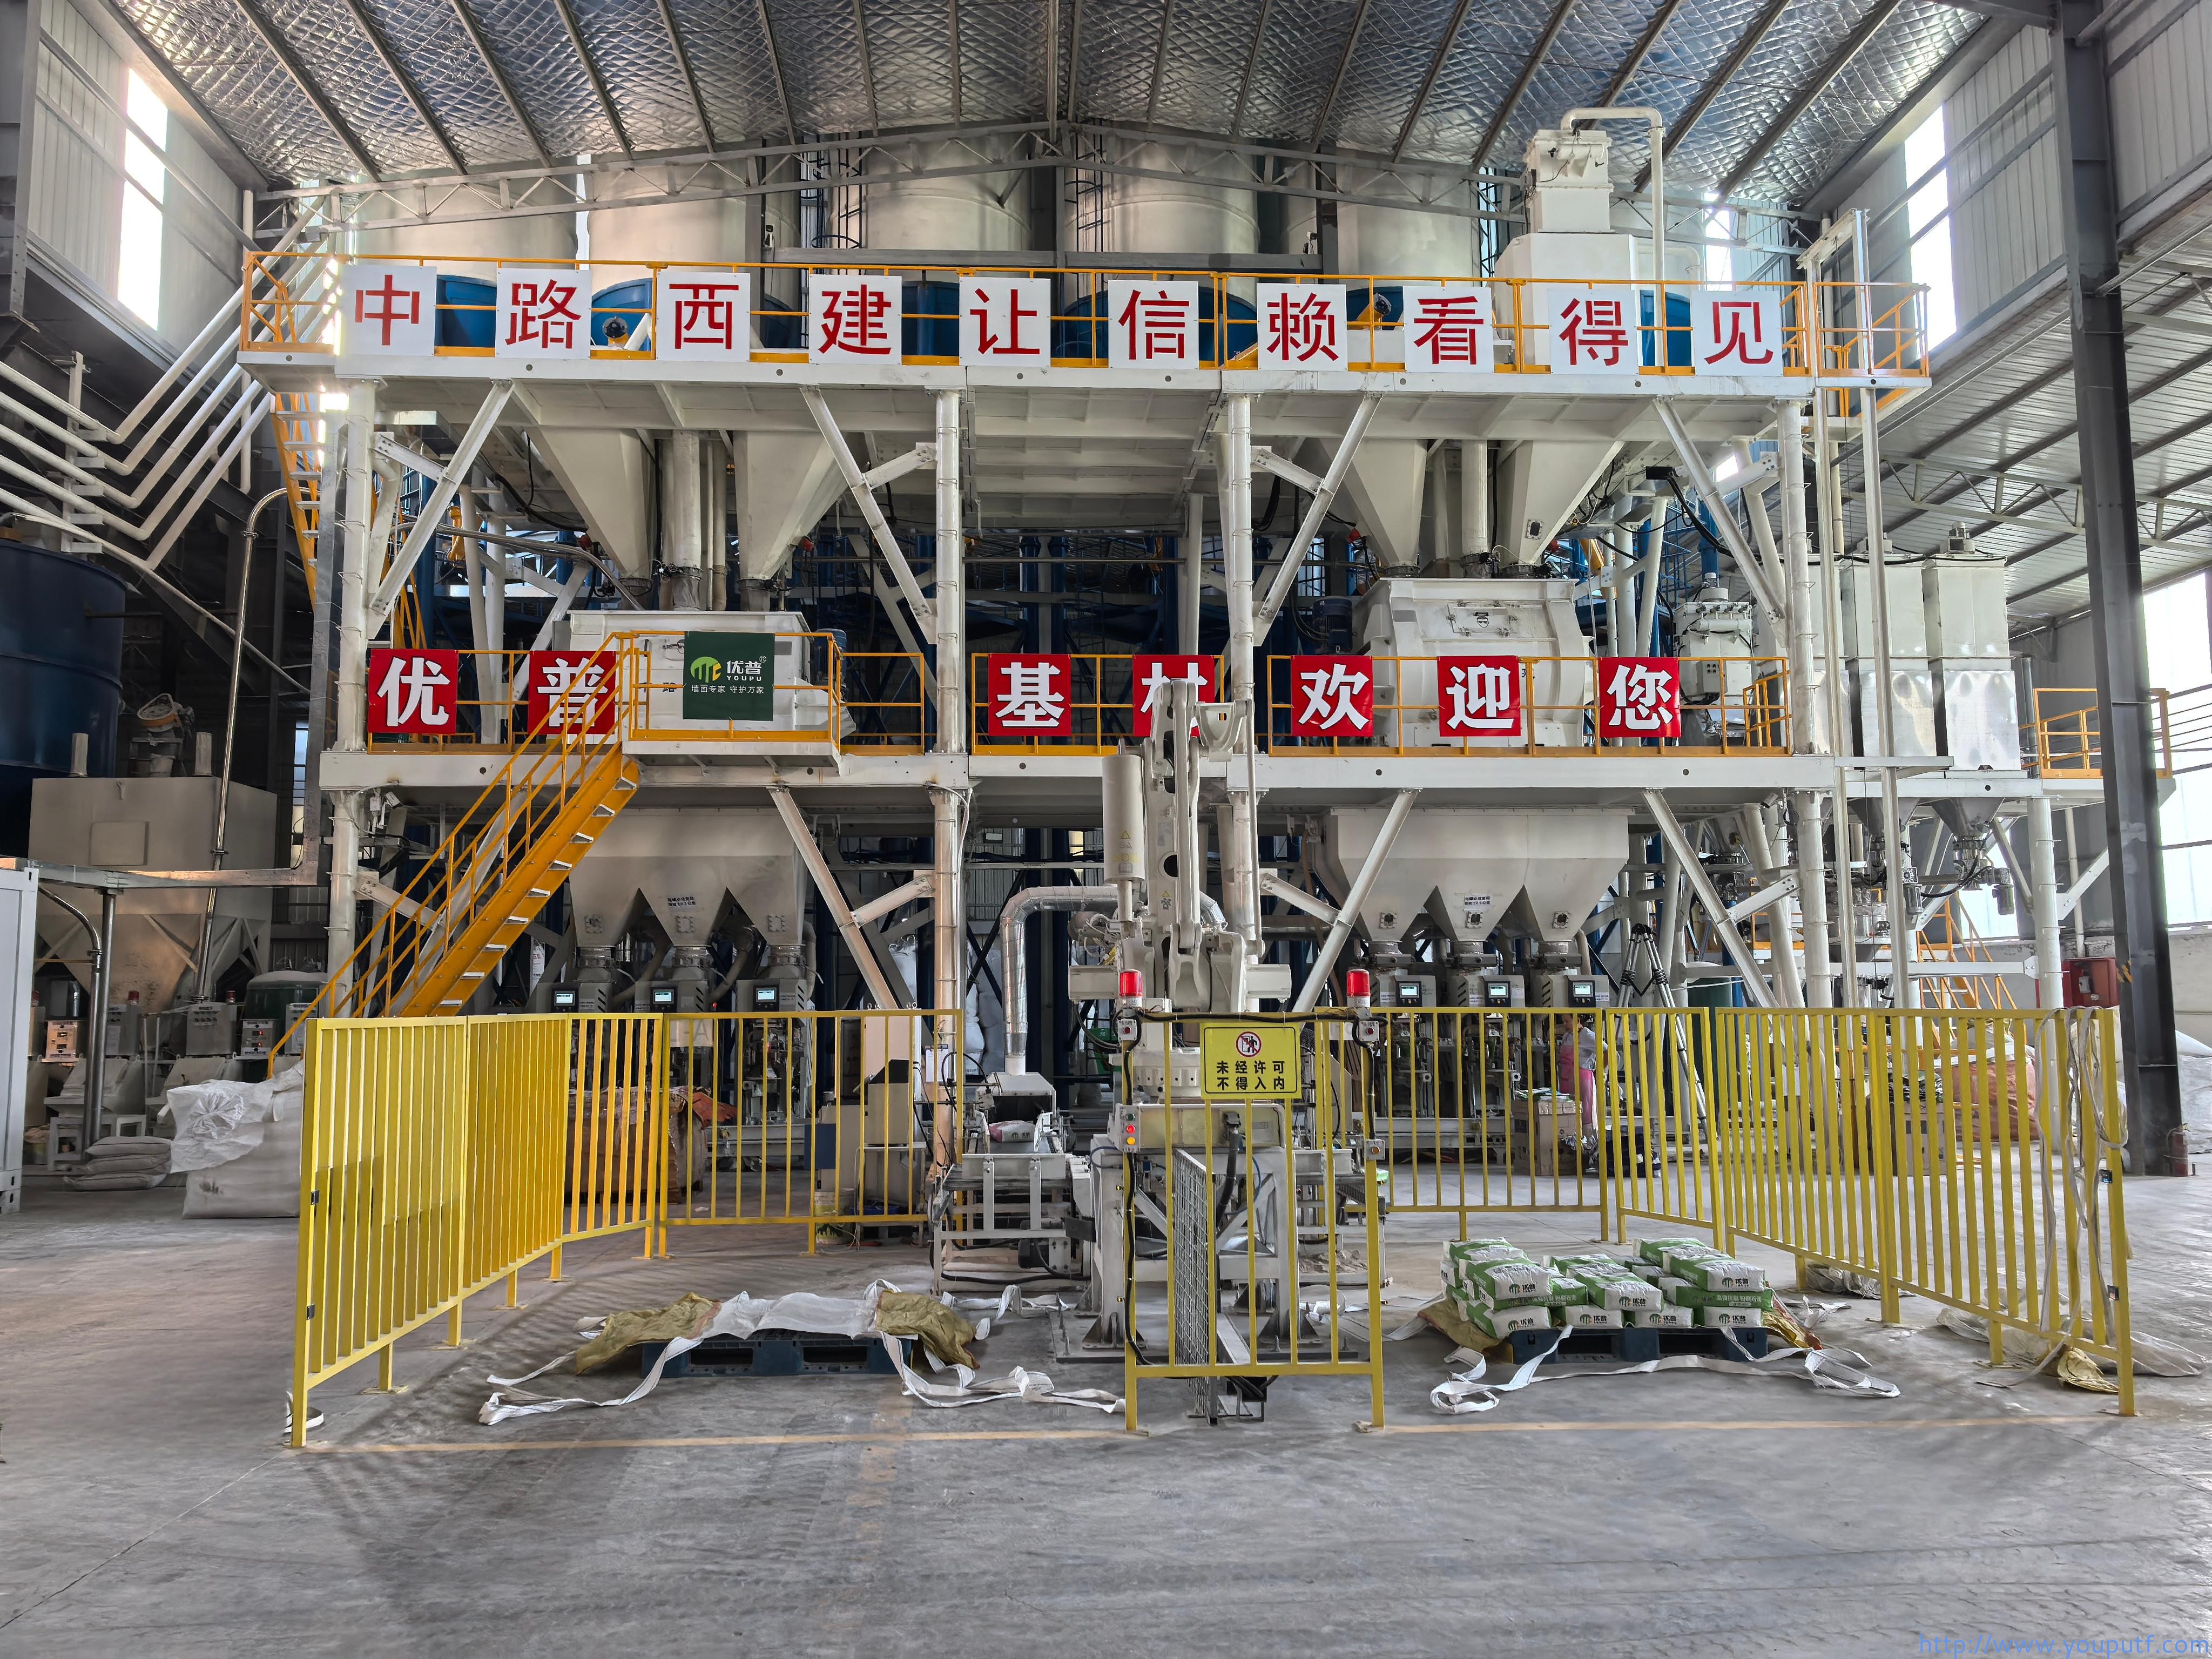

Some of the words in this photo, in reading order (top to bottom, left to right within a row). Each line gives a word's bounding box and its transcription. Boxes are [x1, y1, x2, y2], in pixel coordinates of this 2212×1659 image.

[356, 274, 1774, 367] 中路西建让信赖看得见
[691, 685, 726, 693] 墙面专家
[730, 685, 764, 694] 守护万家
[1216, 1060, 1285, 1075] 未经许可
[1216, 1076, 1286, 1091] 不得入内
